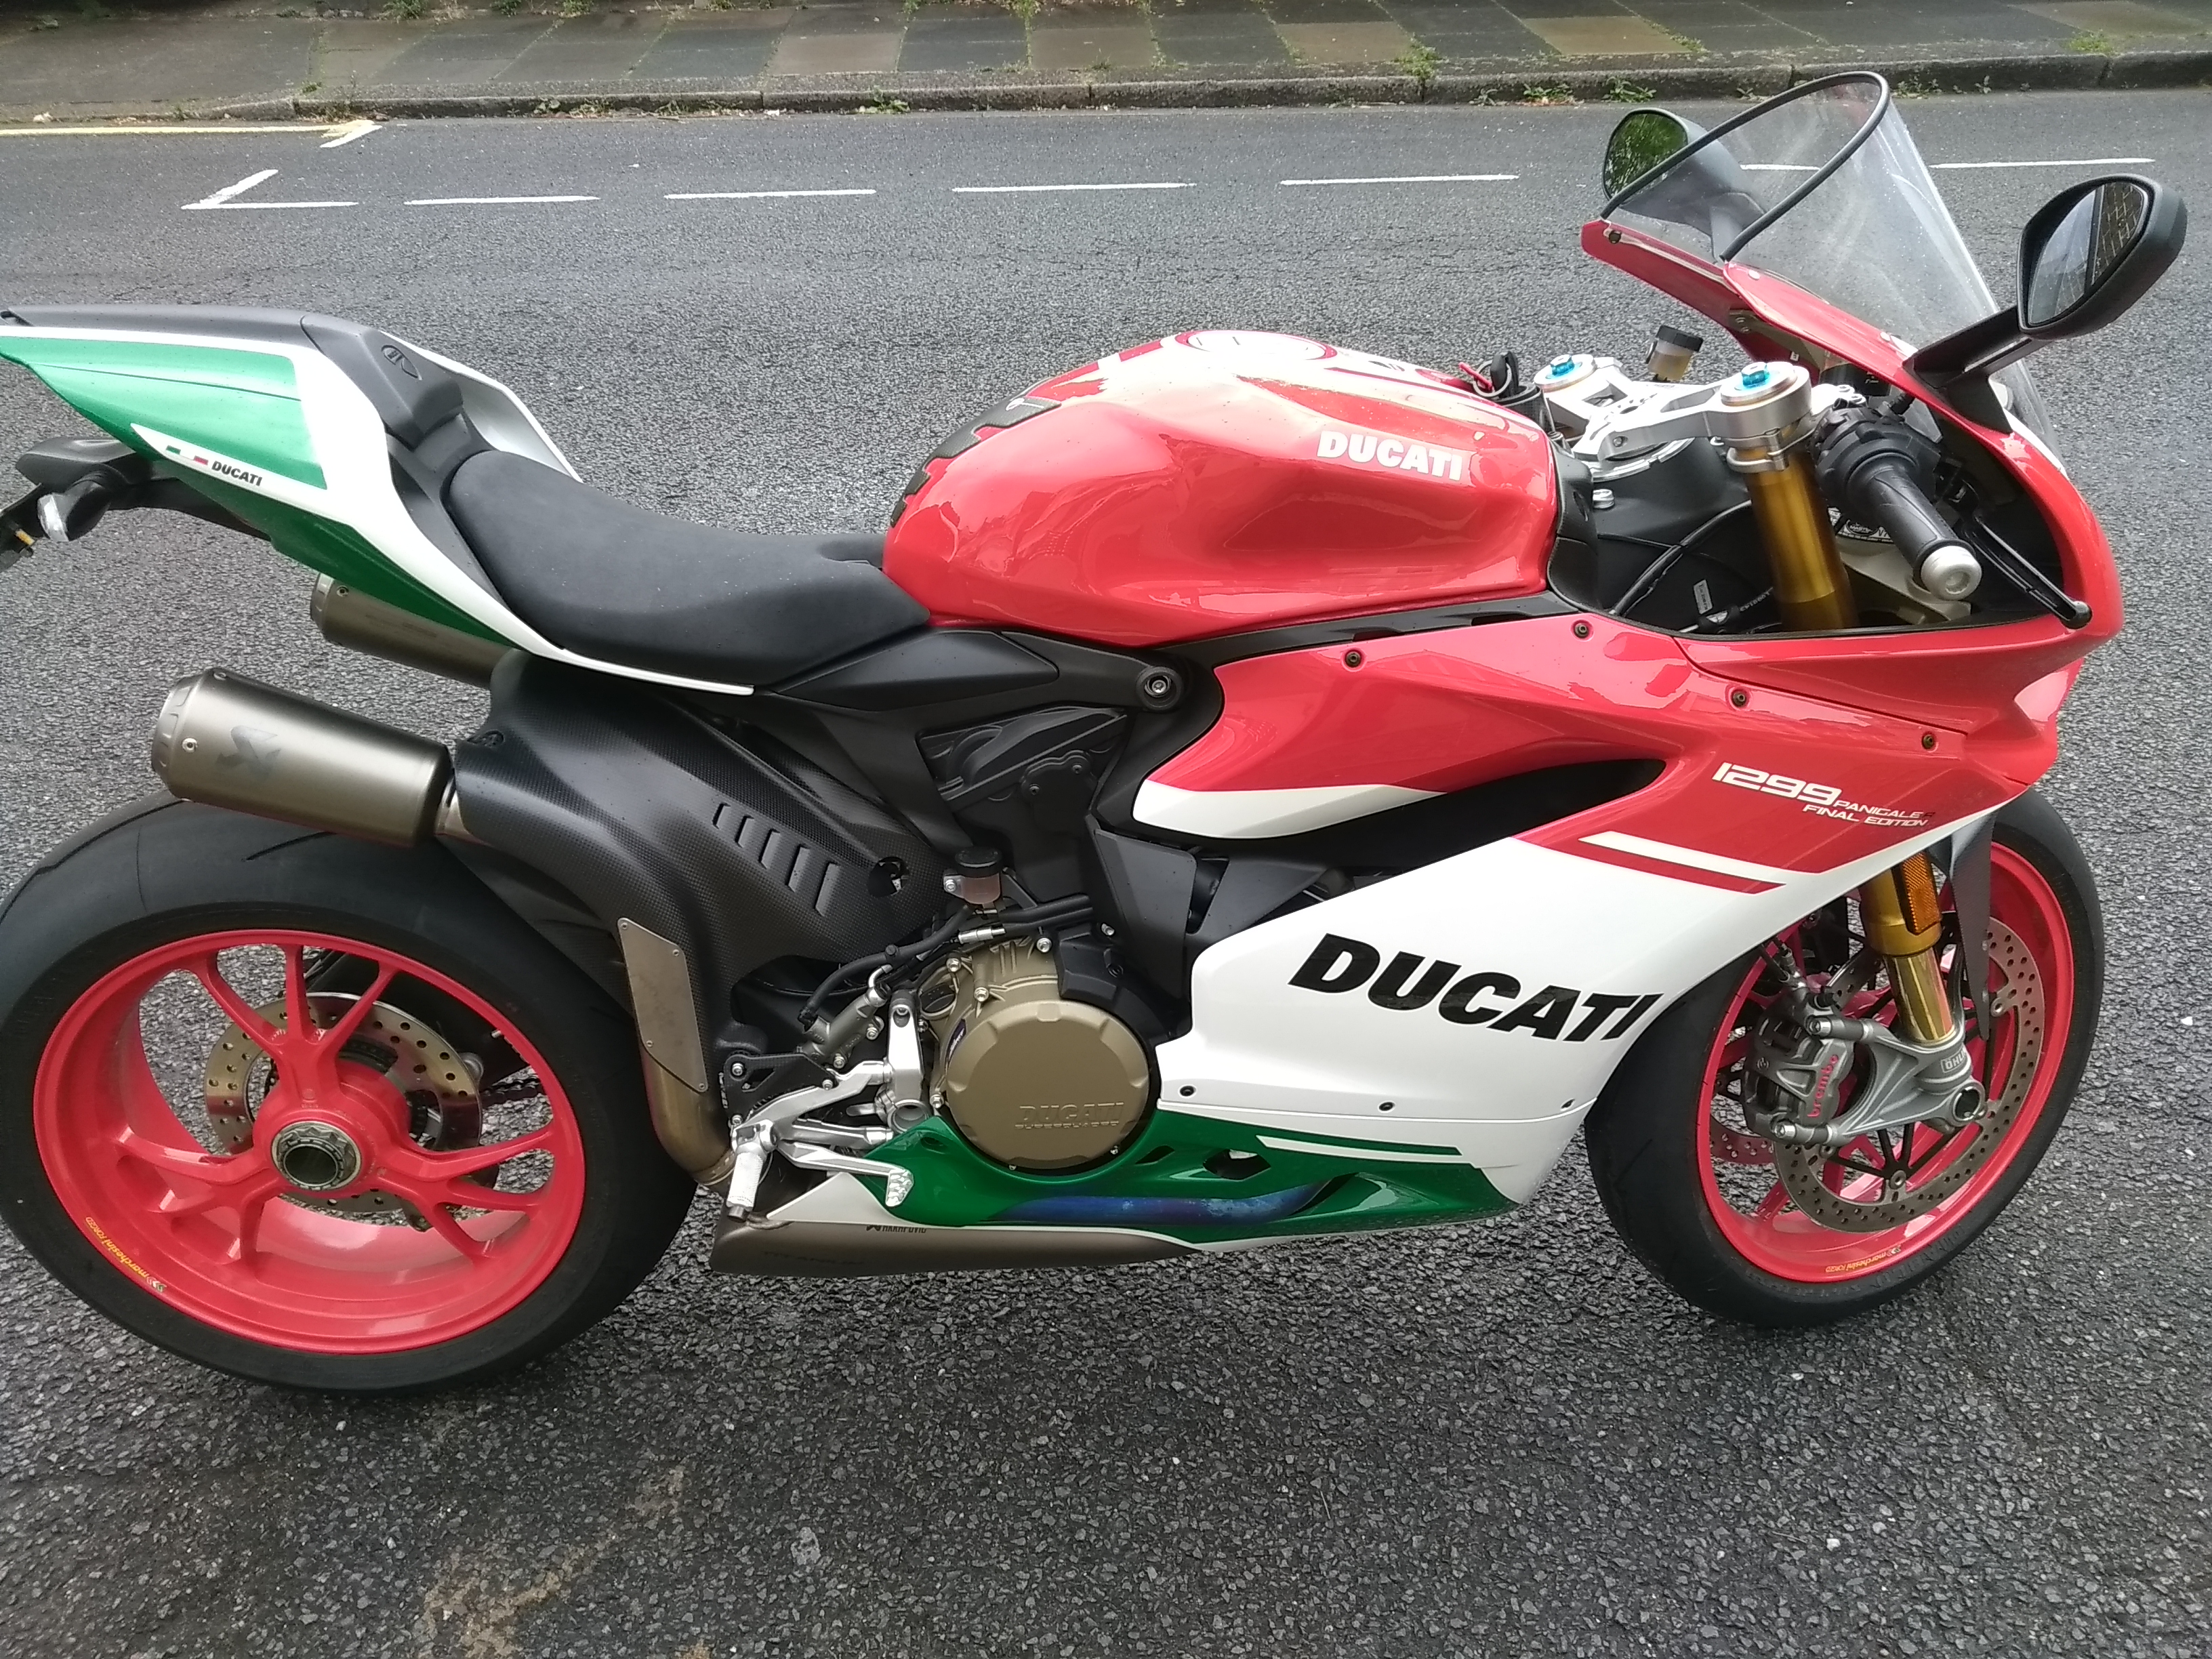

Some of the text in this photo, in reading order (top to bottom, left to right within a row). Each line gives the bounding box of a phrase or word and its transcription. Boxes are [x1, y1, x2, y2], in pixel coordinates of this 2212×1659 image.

[211, 460, 262, 486] DUCATI
[1317, 430, 1462, 480] DUCATI
[1711, 762, 1843, 806] 1299
[1833, 800, 1923, 818] PANIGALE
[1803, 804, 1929, 826] FINAL EDITION
[1288, 933, 1664, 1042] DUCATI
[1807, 1054, 1839, 1118] brembo
[1018, 1101, 1125, 1124] DUCATI
